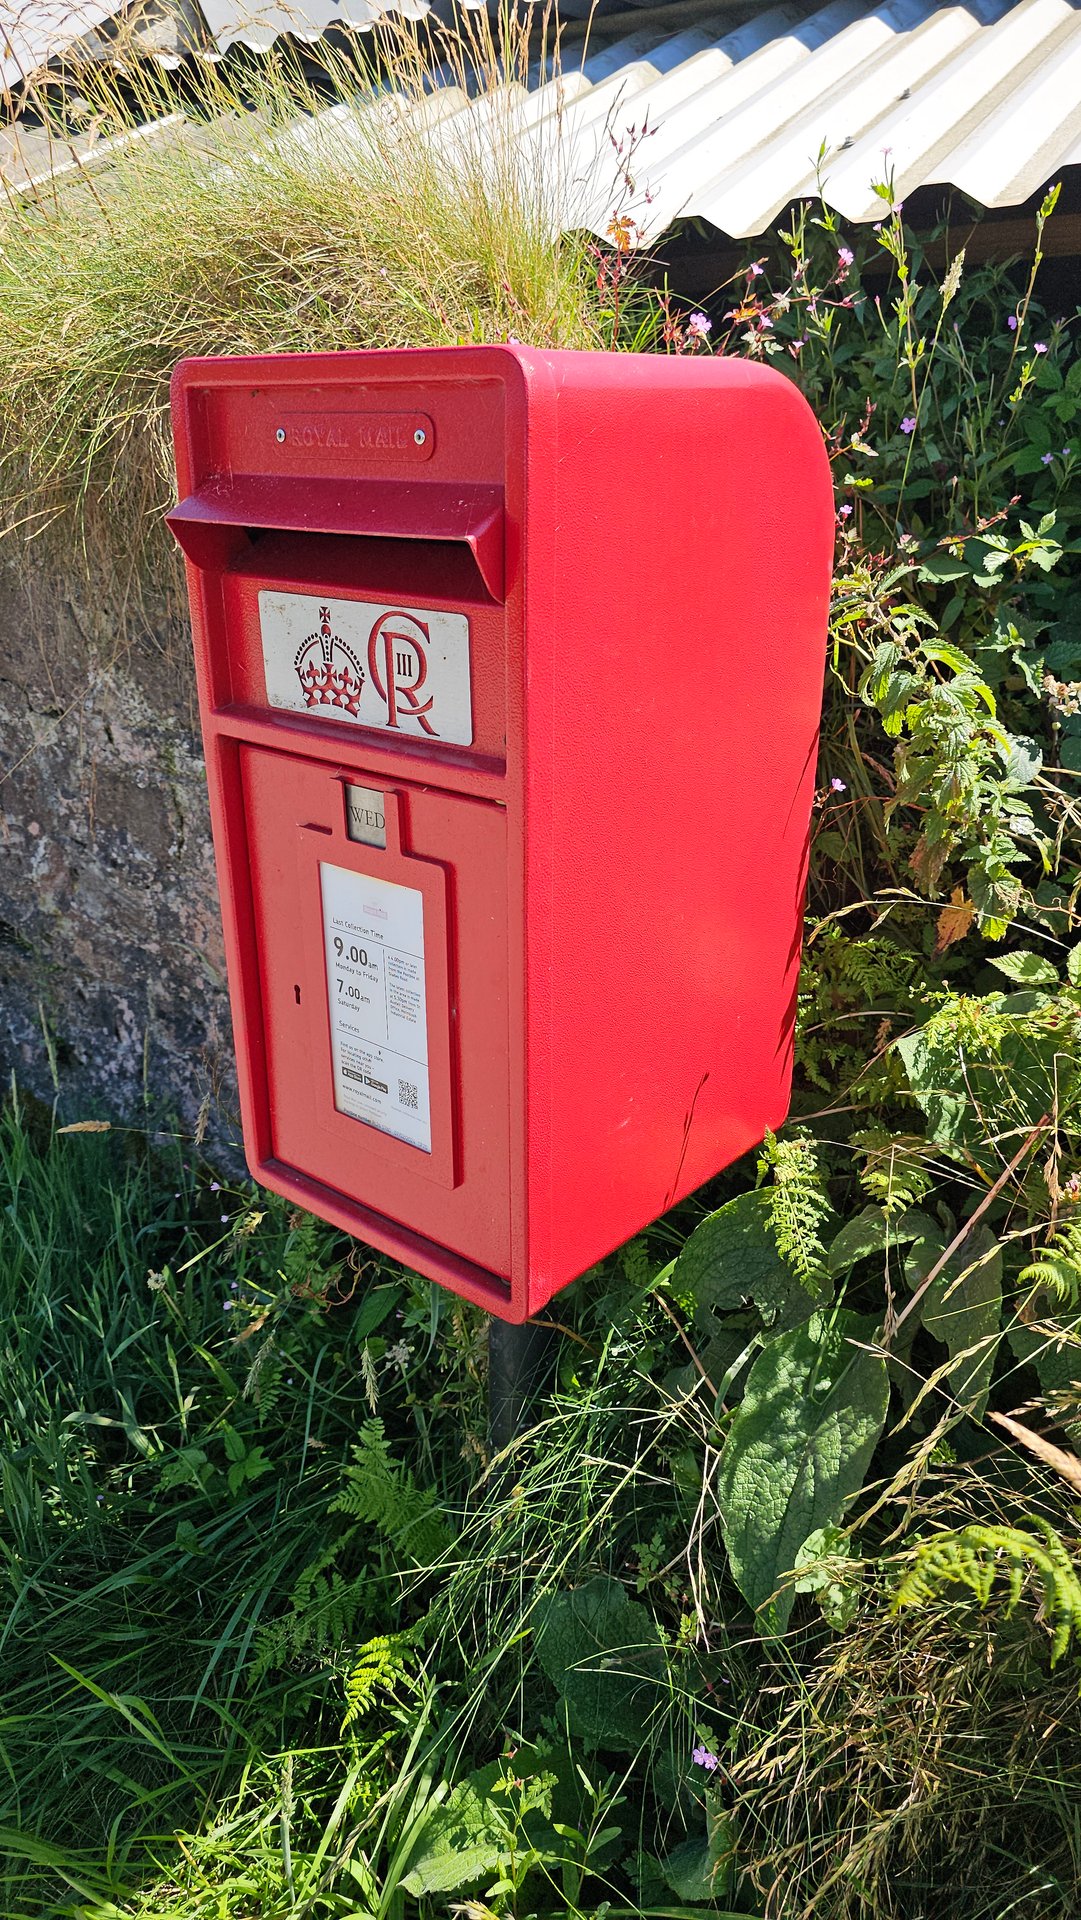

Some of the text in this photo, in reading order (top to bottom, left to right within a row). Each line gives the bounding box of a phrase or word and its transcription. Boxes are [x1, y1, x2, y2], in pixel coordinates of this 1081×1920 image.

[291, 427, 407, 448] ROYAL MAIL
[350, 806, 385, 829] WED
[333, 917, 384, 940] Last Collection Time
[336, 962, 355, 976] Monday
[363, 972, 378, 984] Friday
[338, 998, 360, 1013] Saturday
[339, 1020, 360, 1033] Services
[343, 1084, 382, 1105] www.royalmail.com
